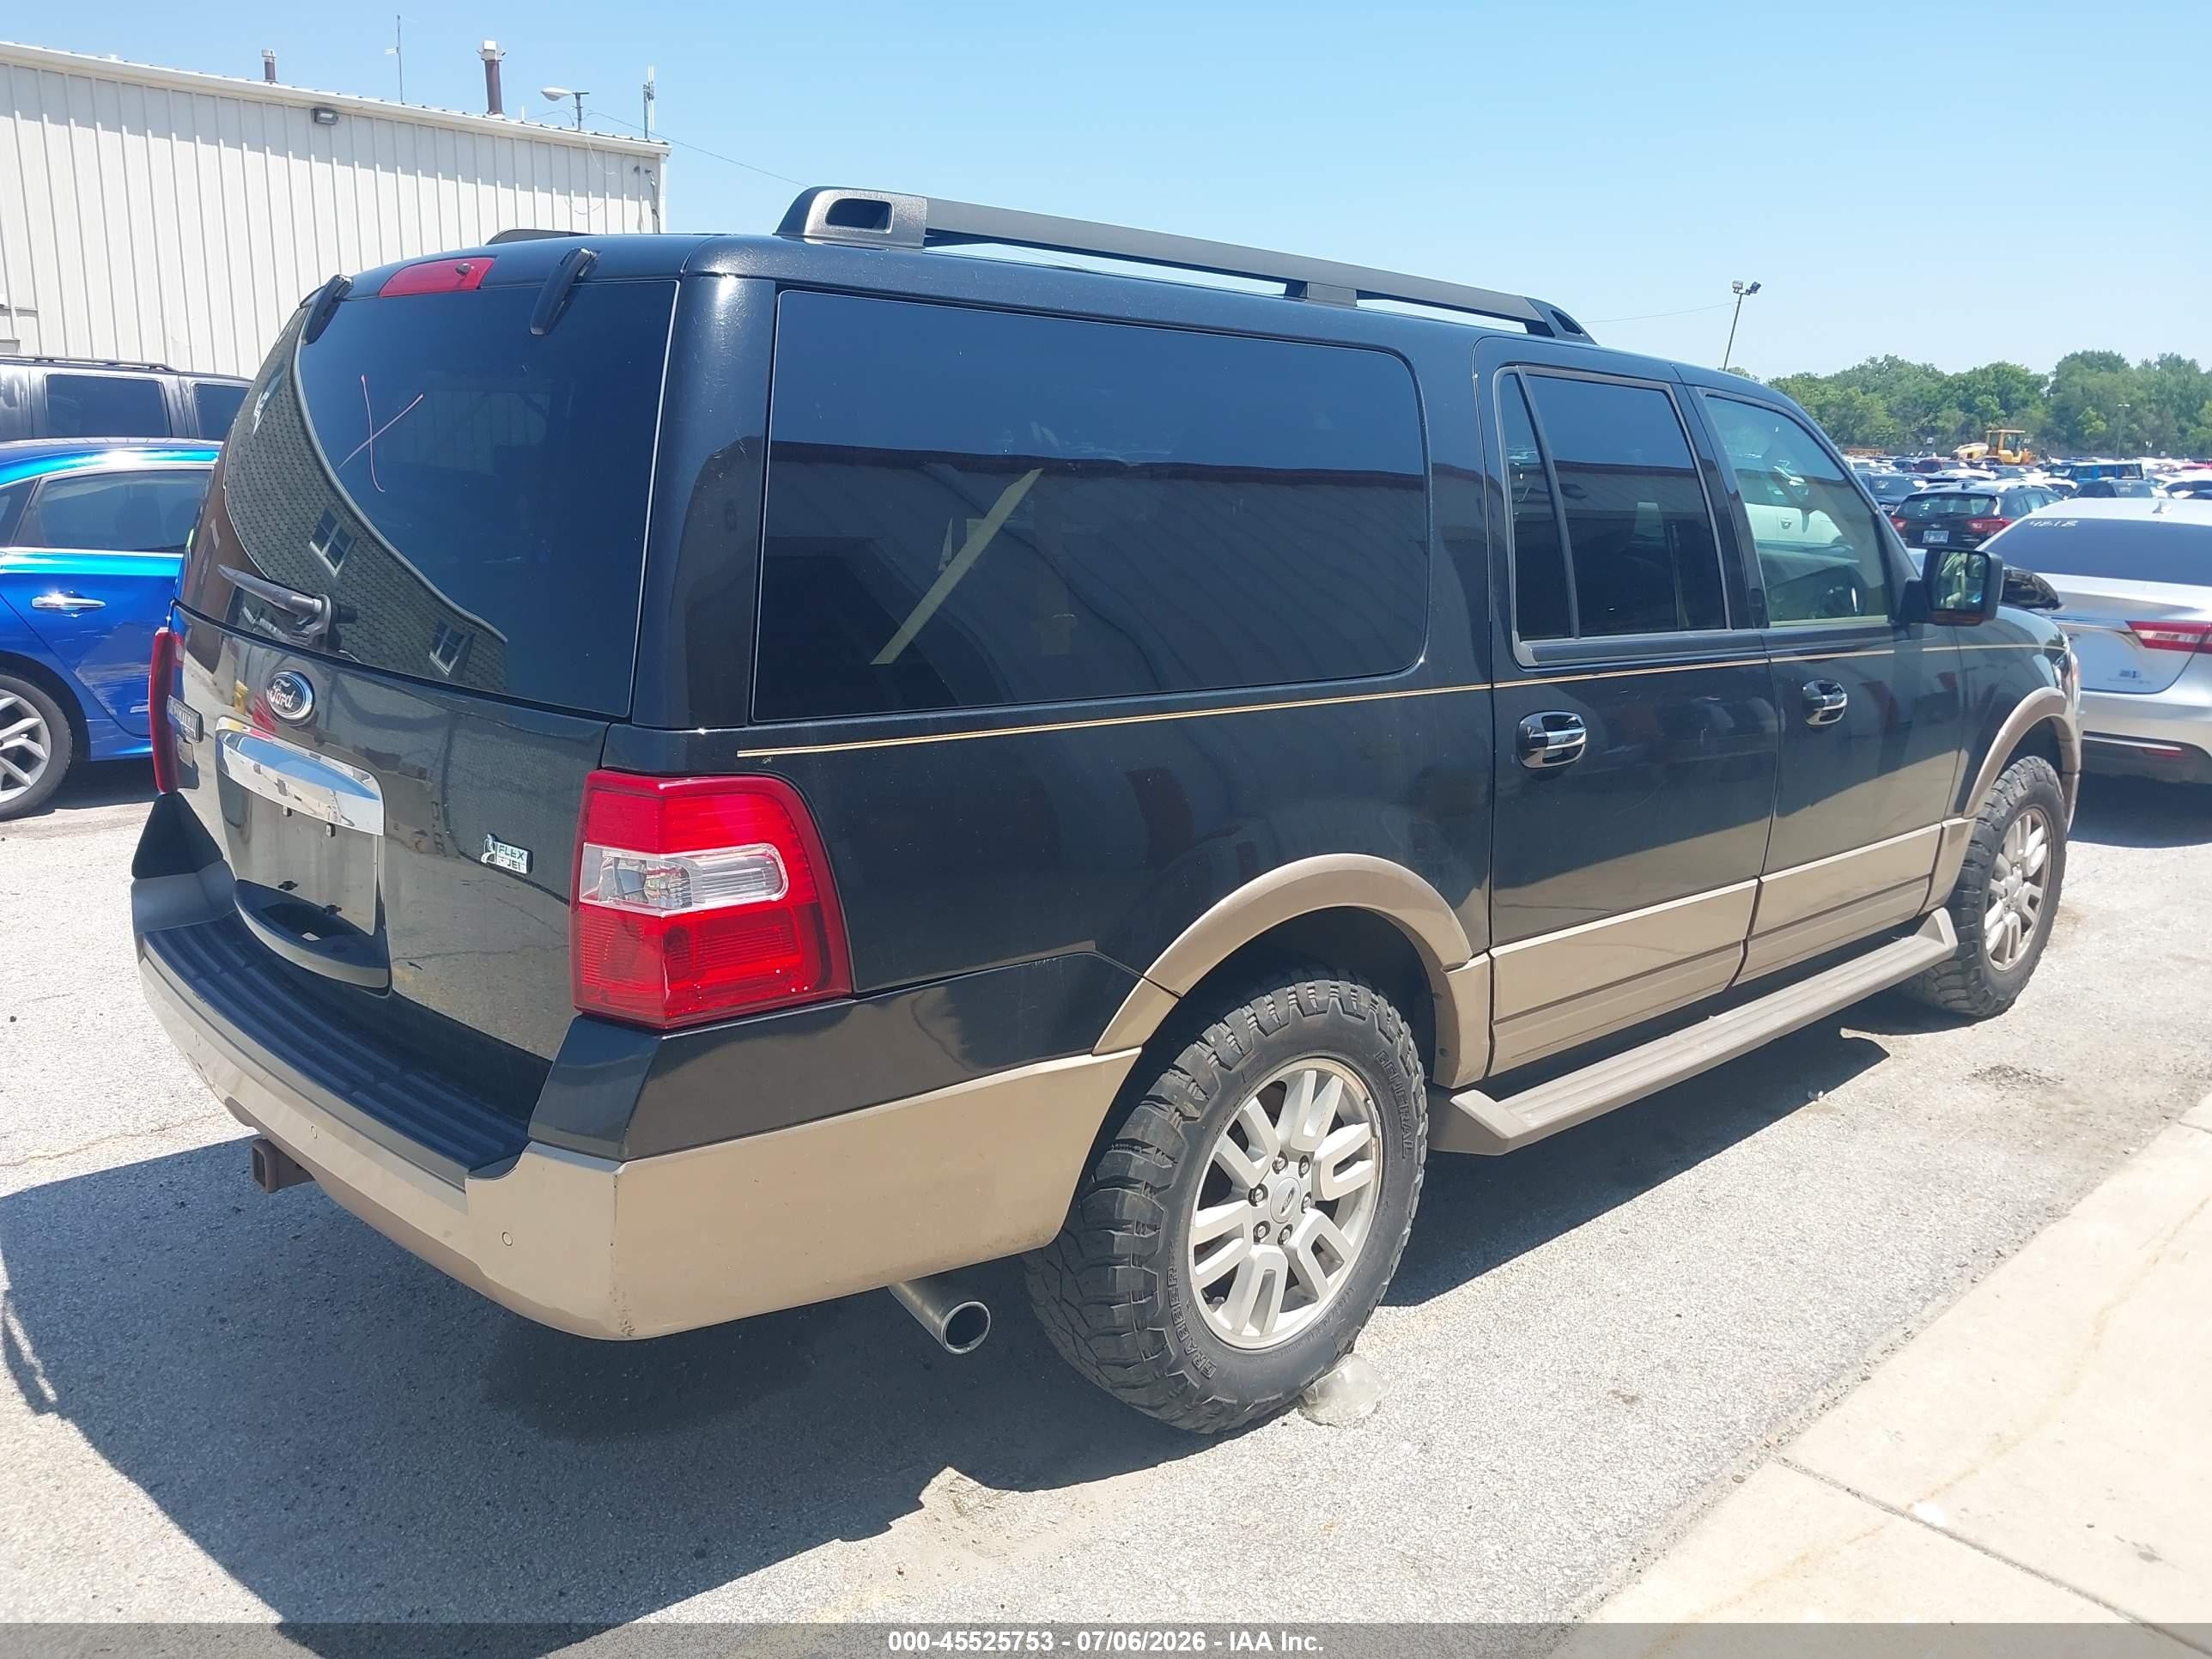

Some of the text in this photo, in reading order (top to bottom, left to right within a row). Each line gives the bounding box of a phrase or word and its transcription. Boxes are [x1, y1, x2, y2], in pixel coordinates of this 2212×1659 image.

[267, 678, 296, 709] Ford
[498, 844, 525, 861] FLEX
[1375, 1049, 1413, 1159] GENERAL
[1167, 1265, 1217, 1380] GRABBER
